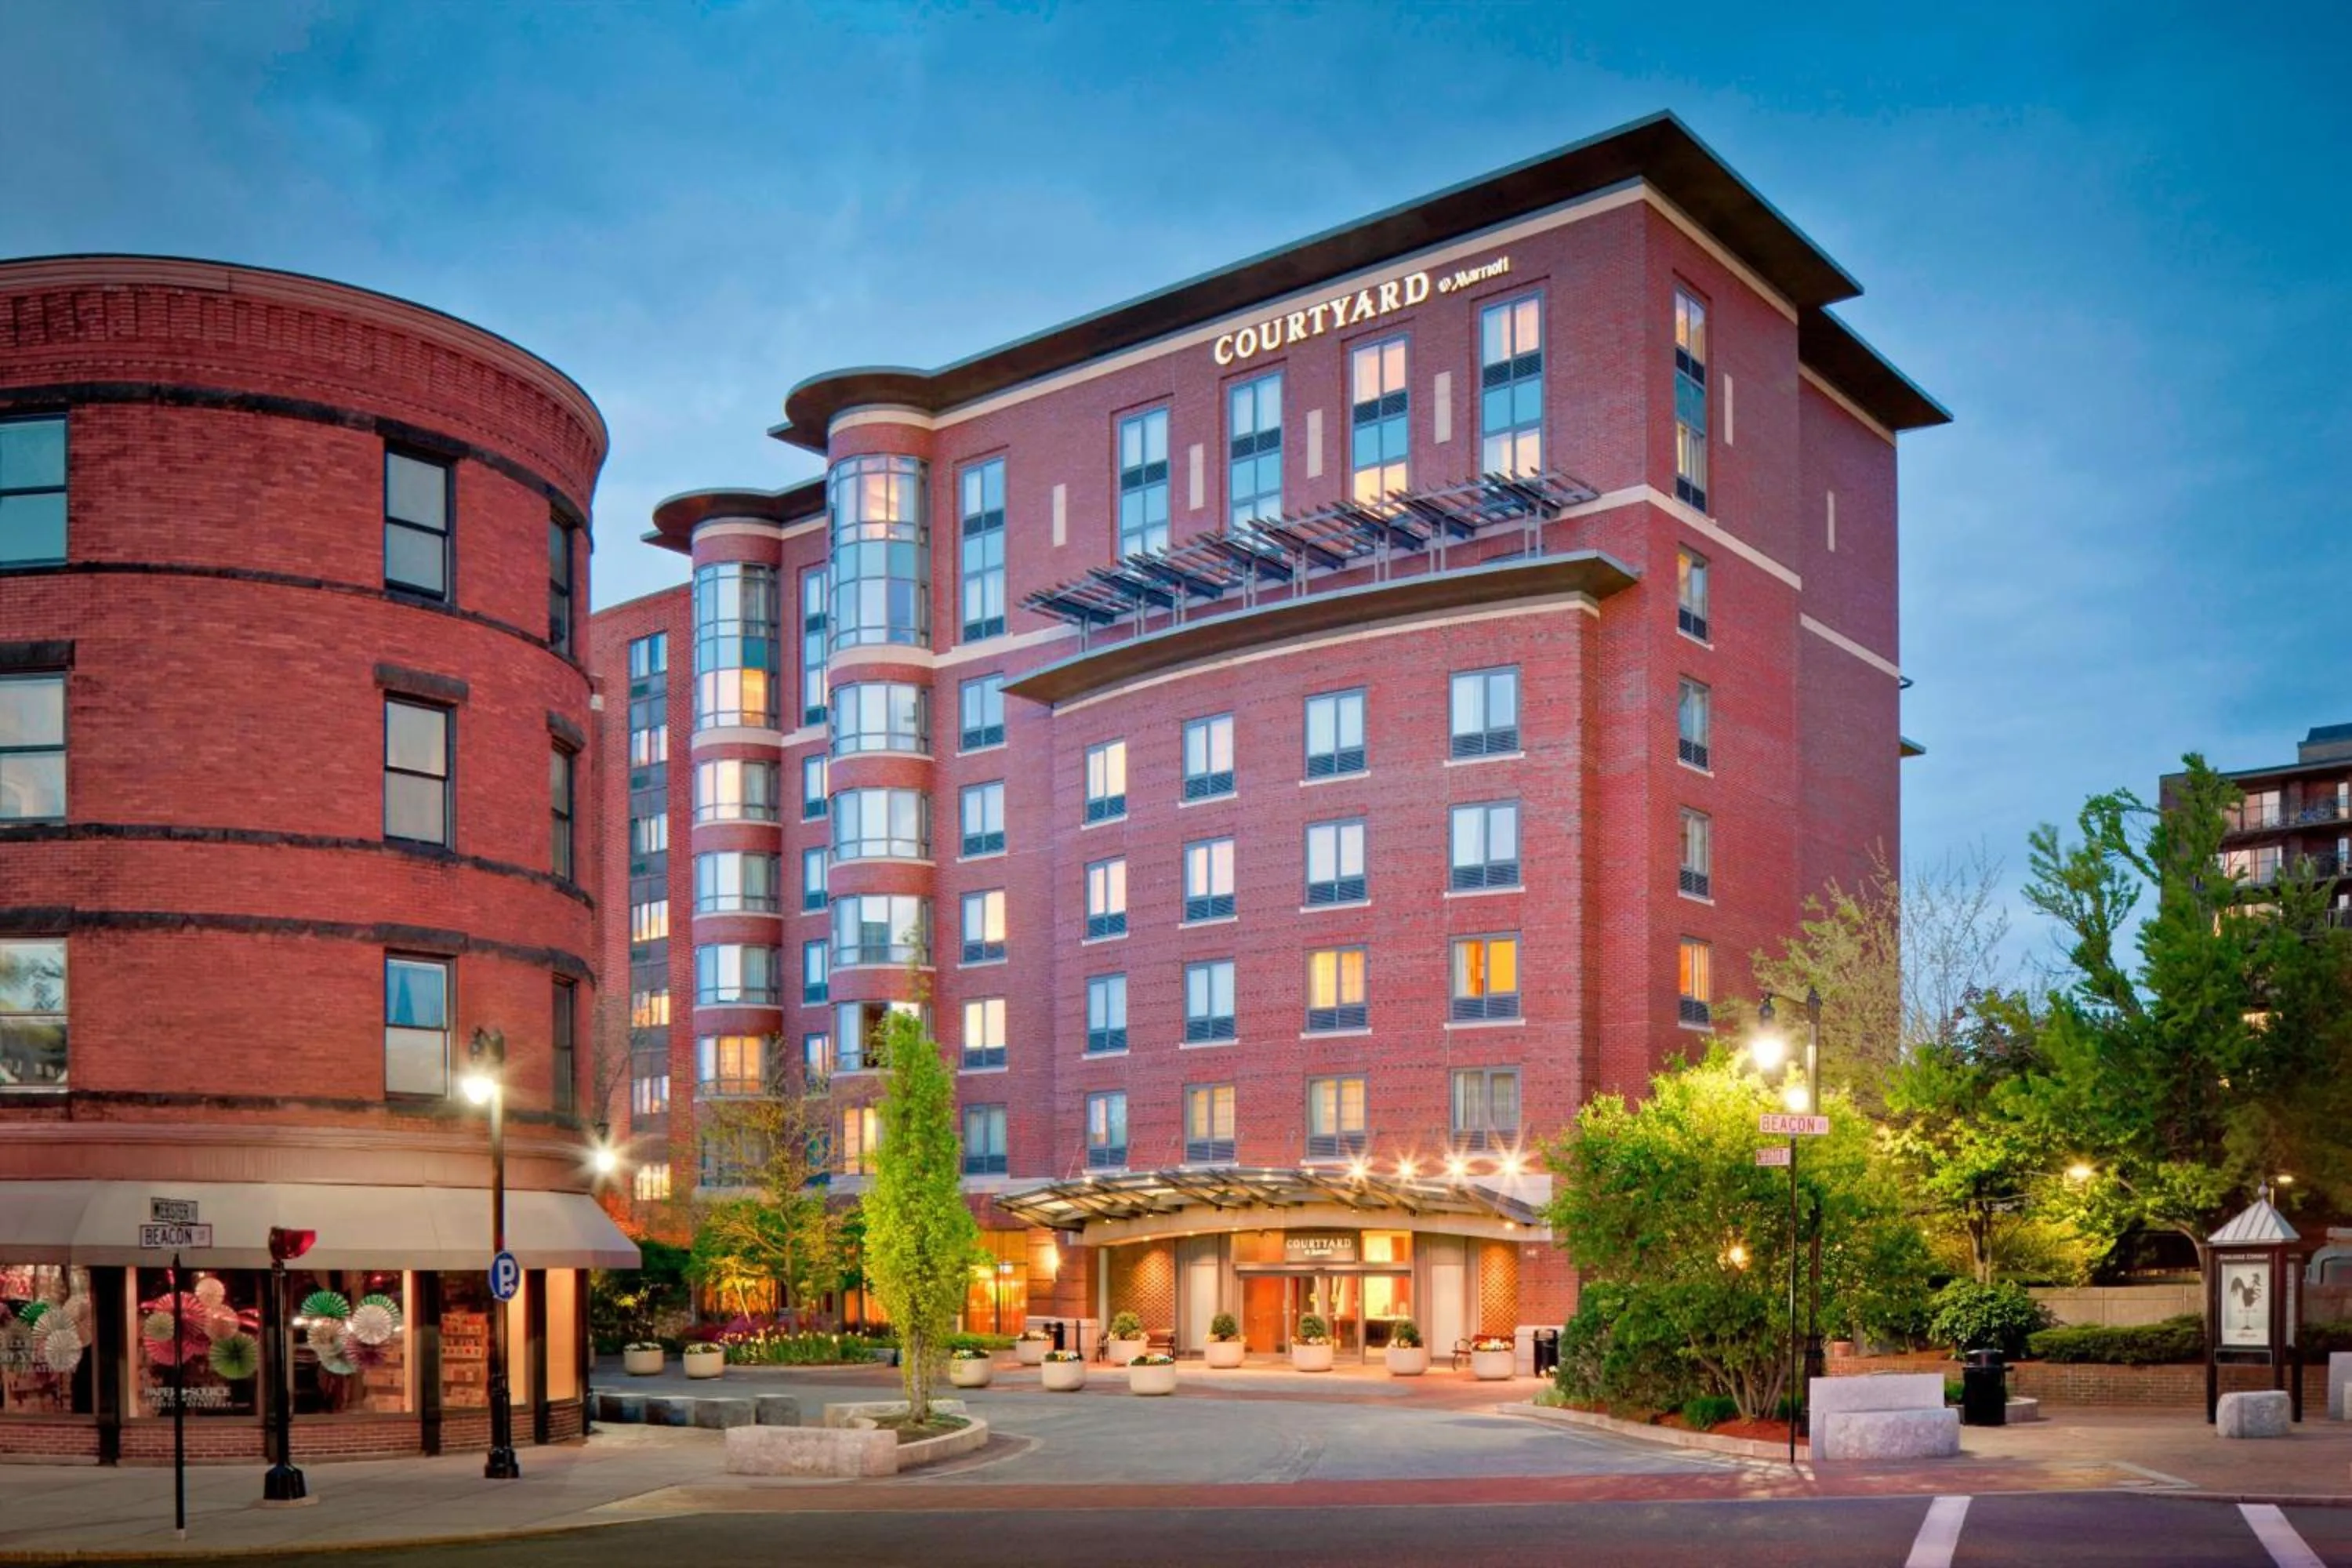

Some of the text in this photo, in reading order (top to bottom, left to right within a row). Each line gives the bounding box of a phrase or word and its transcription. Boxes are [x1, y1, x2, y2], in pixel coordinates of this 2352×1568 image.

[1214, 271, 1430, 365] COURTYARD
[1762, 1116, 1815, 1132] BEACON
[145, 1228, 192, 1245] BEACON
[1286, 1238, 1352, 1249] COURTYARD
